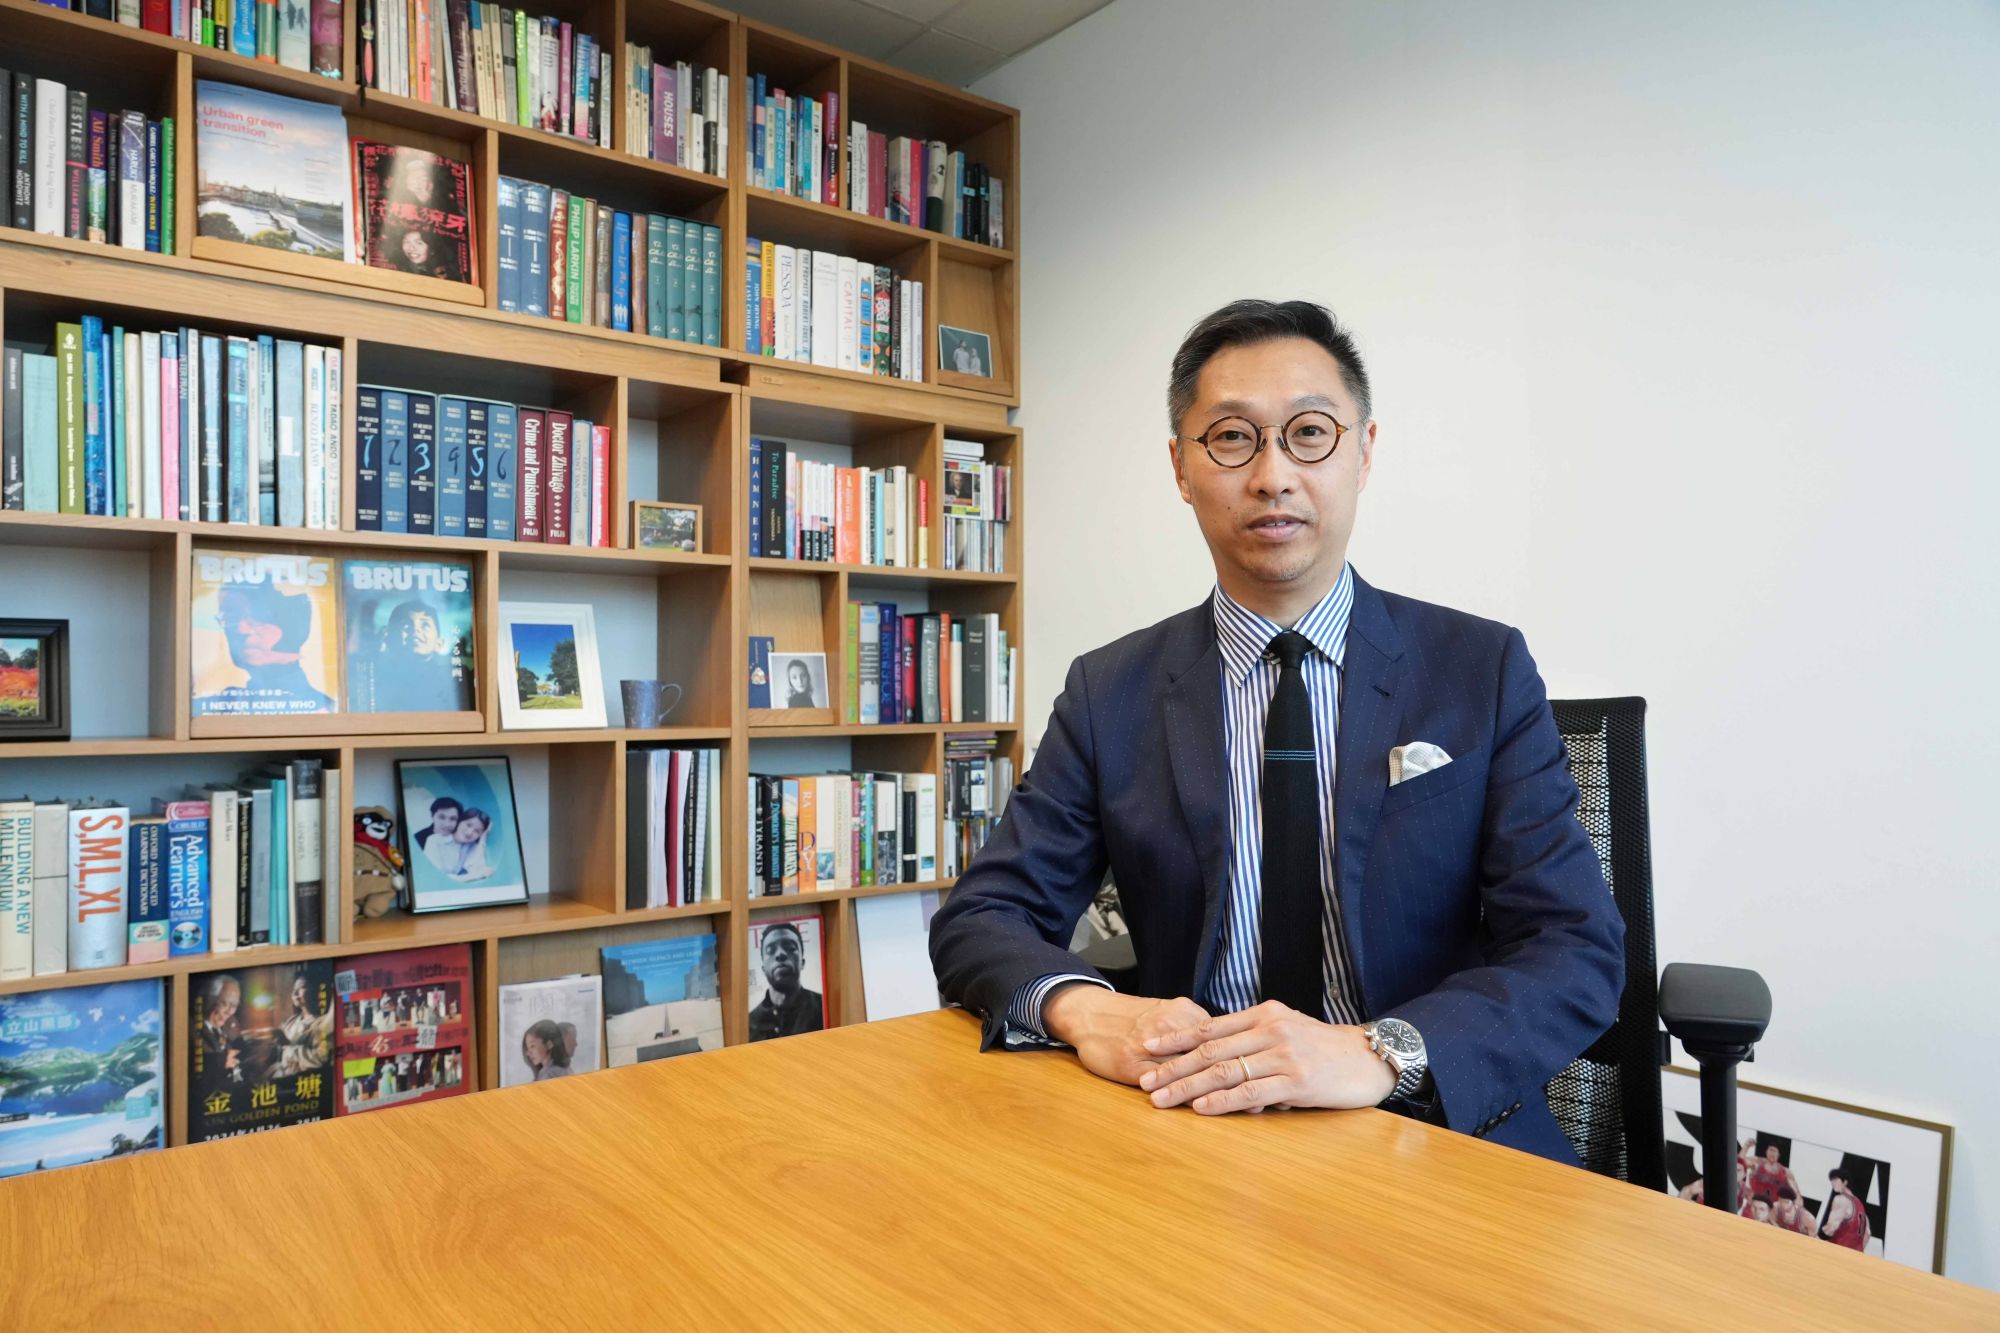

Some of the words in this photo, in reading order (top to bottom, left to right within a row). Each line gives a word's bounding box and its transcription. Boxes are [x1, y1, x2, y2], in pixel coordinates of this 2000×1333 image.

[71, 97, 82, 159] RESTLESS
[93, 117, 104, 133] Ali
[203, 104, 243, 121] Urban
[246, 115, 284, 132] green
[203, 118, 267, 139] transition
[663, 91, 673, 137] HOUSES
[92, 134, 104, 168] Smith
[129, 149, 139, 179] HARUKI
[16, 169, 24, 206] HOROWITZ
[71, 169, 80, 206] WILLIAM
[571, 203, 580, 239] PHILIP
[570, 240, 579, 281] LARKIN
[782, 255, 792, 308] PESSOA
[843, 280, 853, 330] CAPITAL
[311, 403, 320, 433] RENZO
[329, 404, 338, 431] TADAO
[524, 418, 540, 447] Crime
[311, 437, 320, 467] PIANO
[329, 434, 338, 459] ANDO
[385, 439, 401, 466] 2
[551, 422, 567, 454] Doctor
[414, 442, 431, 475] 3
[470, 447, 484, 478] 5
[497, 449, 508, 480] 6
[524, 447, 540, 466] and
[771, 452, 780, 462] To
[549, 455, 567, 493] Zhivago
[771, 464, 780, 500] Paradise
[524, 467, 540, 520] Punishment
[752, 456, 760, 542] HAMNET
[198, 556, 329, 587] BRUTUS
[351, 565, 469, 593] BRUTUS
[201, 702, 206, 710] I
[210, 701, 249, 710] NEVER
[252, 701, 286, 710] KNEW
[289, 700, 316, 709] WHO
[17, 817, 32, 886] BUILDING
[150, 825, 158, 860] OXFORD
[0, 818, 14, 912] MILLENNIUM
[170, 836, 187, 909] Learner's
[186, 834, 204, 907] Advanced
[17, 889, 31, 899] A
[140, 867, 148, 916] DICTIONARY
[150, 861, 158, 907] ADVANCED
[16, 903, 31, 935] NEW
[230, 1106, 281, 1123] GOLDEN
[285, 1100, 319, 1115] POND
